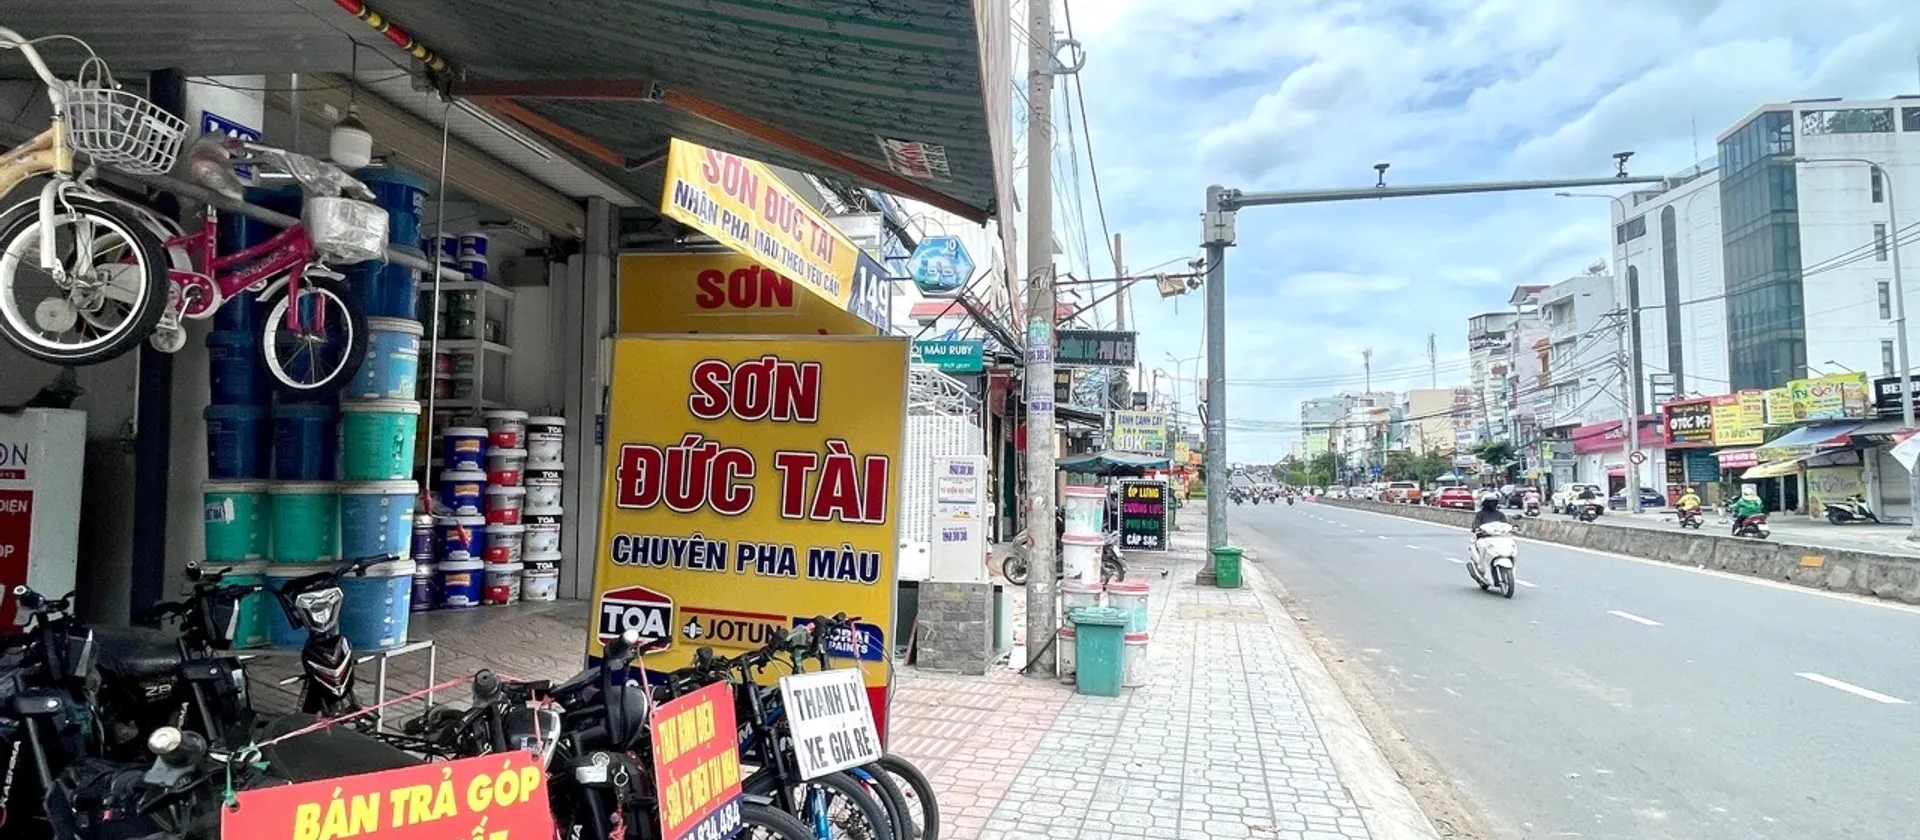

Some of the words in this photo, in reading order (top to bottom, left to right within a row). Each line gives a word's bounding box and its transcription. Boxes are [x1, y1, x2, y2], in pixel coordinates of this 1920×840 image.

[674, 180, 718, 226] NHẬN
[722, 210, 749, 241] PHA
[754, 228, 778, 261] MÀU
[782, 246, 803, 276] THEO
[806, 260, 822, 287] YÊU
[695, 265, 793, 309] SƠN
[859, 266, 889, 318] 149
[949, 345, 973, 355] RUBY
[689, 356, 821, 422] SƠN
[616, 434, 756, 516] ĐỨC
[775, 440, 889, 524] TÀI
[611, 533, 728, 572] CHUYÊN
[735, 542, 798, 577] PHA
[807, 545, 881, 585] MÀU
[604, 605, 666, 637] TOA
[696, 695, 716, 748] ĐIỆN
[793, 684, 844, 721] THANH
[843, 676, 862, 711] LÝ
[803, 736, 829, 770] XE
[829, 722, 855, 764] GIÁ
[856, 718, 873, 758] RẺ
[293, 787, 380, 840] BÁN
[390, 766, 457, 828] TRẢ
[466, 759, 541, 813] GÓP
[681, 775, 694, 820] XE
[692, 758, 711, 814] ĐIỆN
